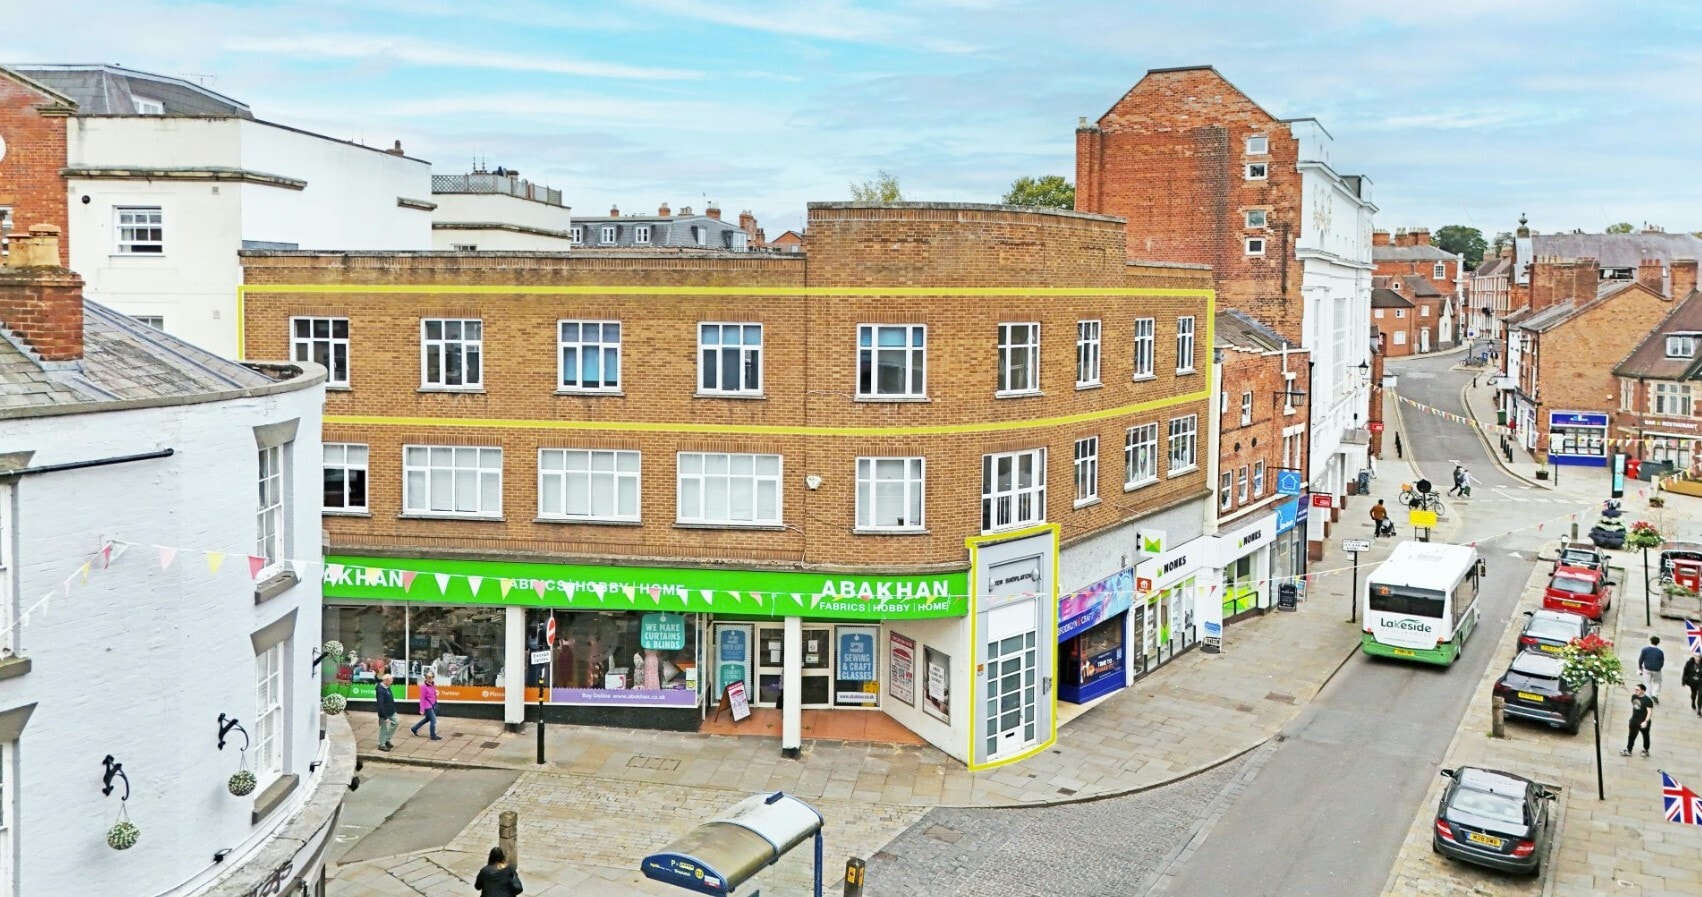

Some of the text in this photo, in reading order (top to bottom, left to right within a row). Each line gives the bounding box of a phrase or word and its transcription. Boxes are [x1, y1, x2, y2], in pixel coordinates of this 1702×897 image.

[1243, 530, 1261, 546] MONKS
[1163, 556, 1186, 574] MONKS
[821, 580, 949, 599] ABAKHAN
[820, 602, 948, 612] FABRICS HOBBY HOME
[645, 623, 680, 632] WE MAKE
[1380, 618, 1432, 633] Lakeside
[644, 632, 681, 640] CURTAINS
[653, 641, 680, 649] BLINDS
[844, 654, 870, 662] SEWING
[842, 662, 872, 671] & CRAFT
[841, 671, 872, 680] CLASSES
